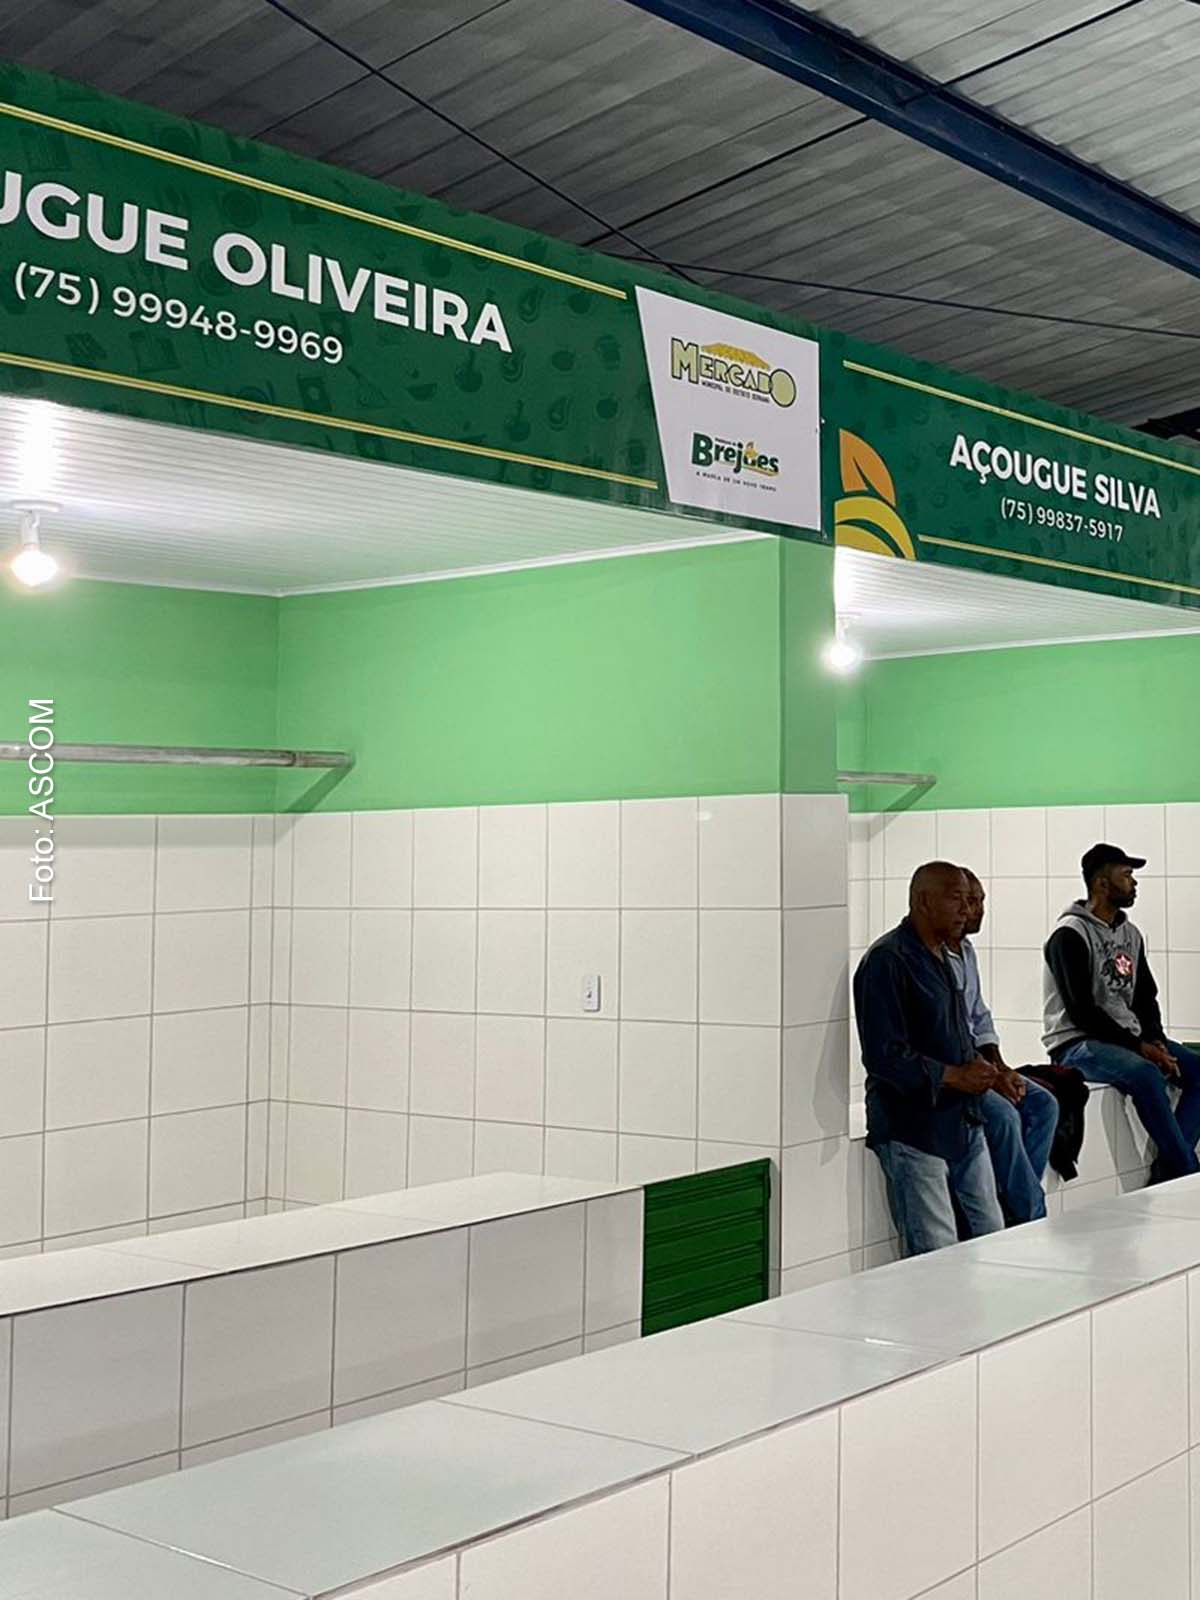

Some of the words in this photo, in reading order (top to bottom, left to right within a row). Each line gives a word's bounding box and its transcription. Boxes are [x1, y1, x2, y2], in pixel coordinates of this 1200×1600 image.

[15, 262, 99, 315] (75)
[112, 286, 343, 364] 99948-9969
[213, 232, 513, 353] OLIVEIRA
[671, 336, 797, 408] MERCADO
[950, 434, 1088, 500] AÇOUGUE
[1094, 473, 1161, 519] SILVA
[1001, 497, 1033, 525] (75)
[1037, 506, 1123, 542] 99837-5917
